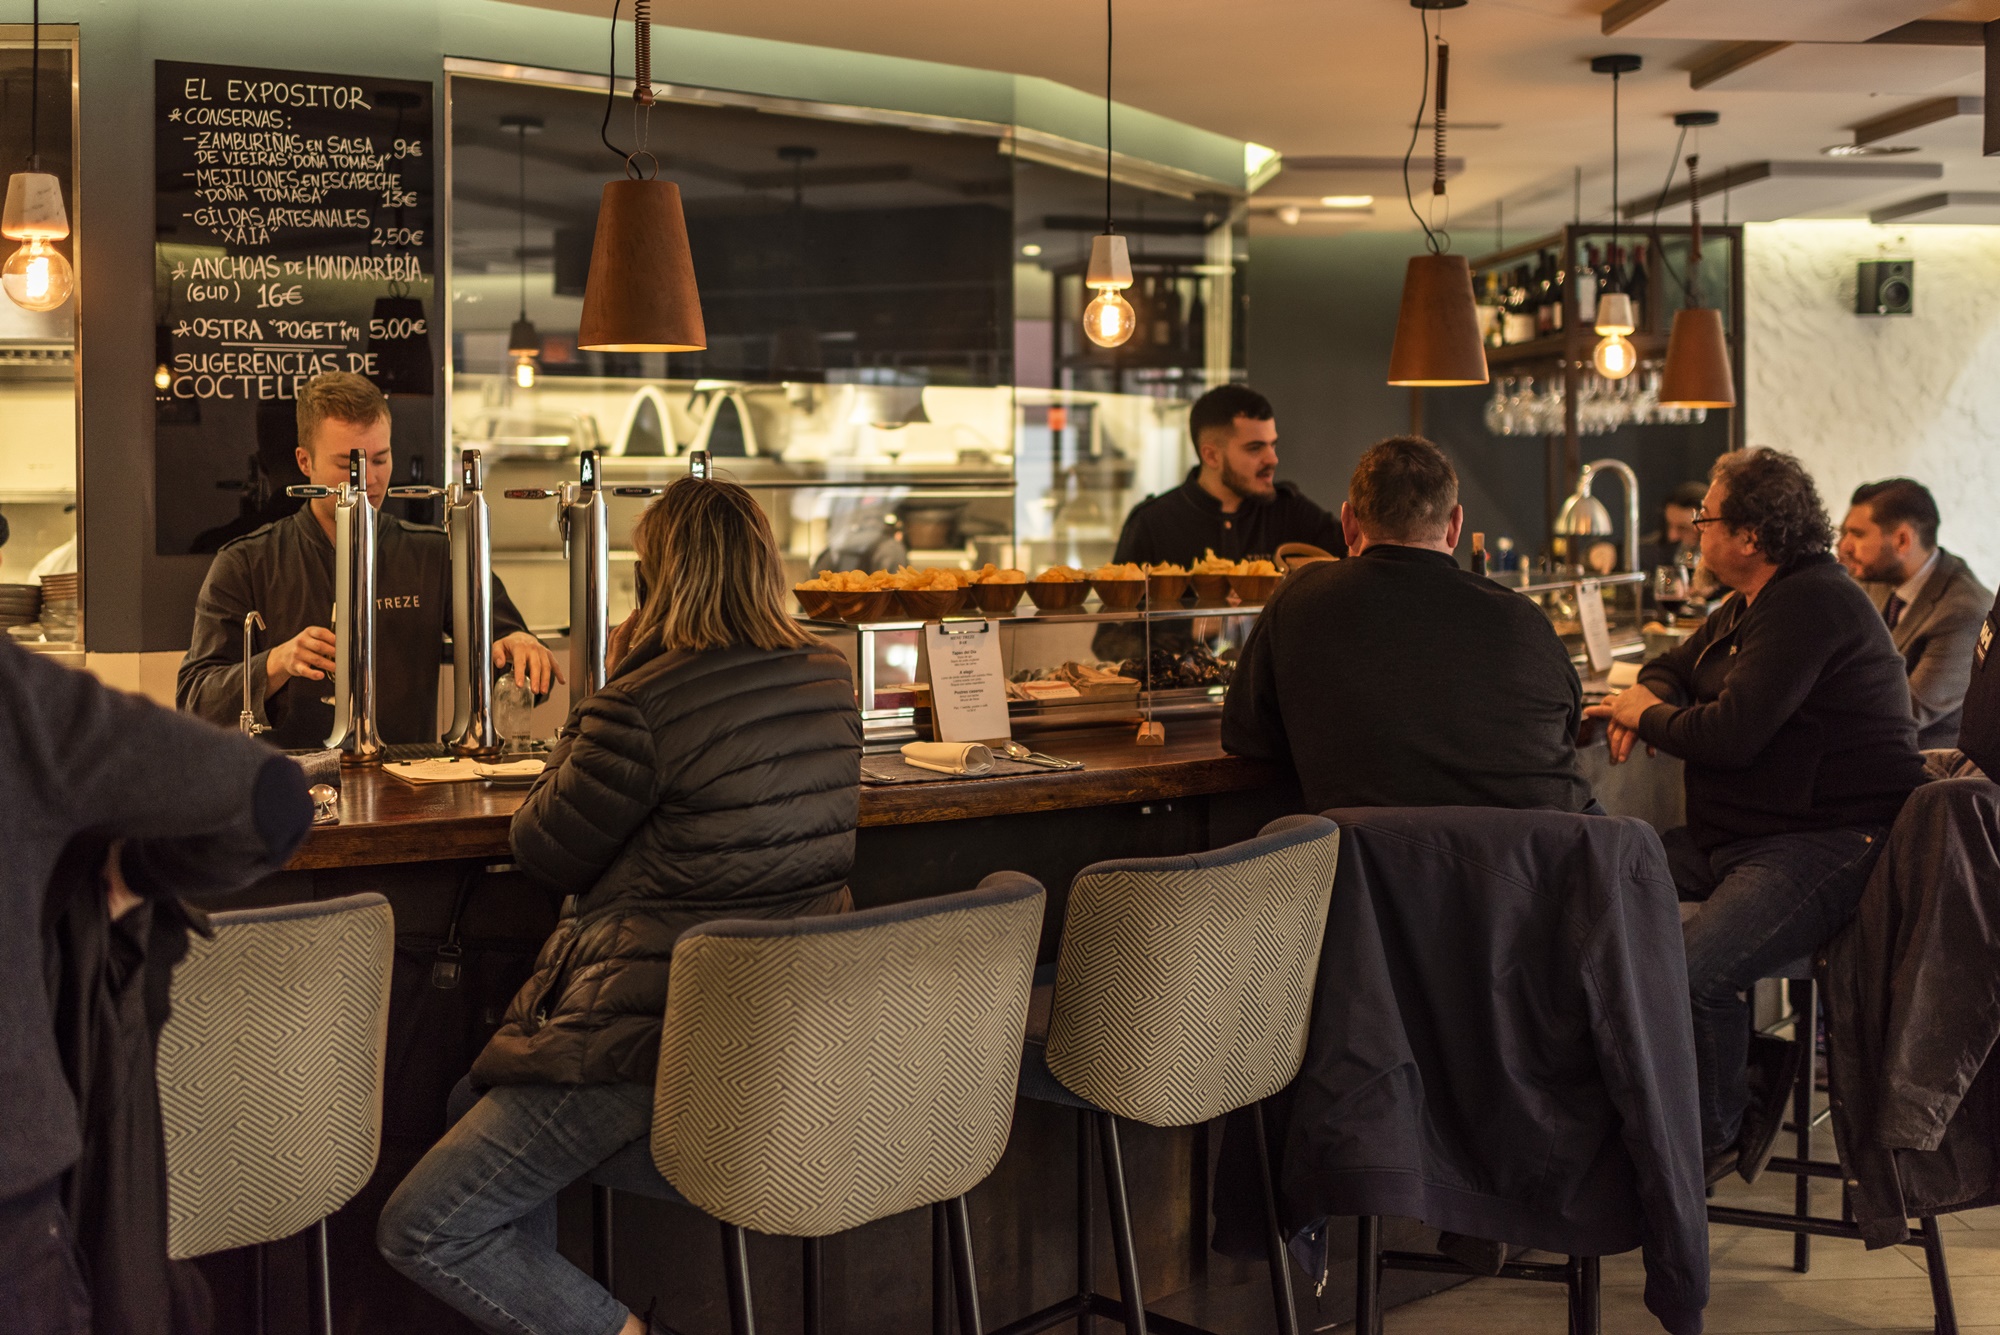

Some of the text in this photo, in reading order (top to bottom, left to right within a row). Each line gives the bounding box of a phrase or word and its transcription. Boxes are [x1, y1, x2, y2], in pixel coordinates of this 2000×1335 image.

[184, 78, 372, 110] EL EXPOSITOR
[184, 107, 292, 129] CONSERVAS:
[194, 149, 220, 164] DE
[222, 150, 288, 167] VIEIRAS
[305, 139, 323, 153] EN
[327, 135, 375, 155] SALSA
[393, 138, 423, 159] 9€
[300, 174, 320, 188] EN
[321, 171, 402, 191] ESCABECHE
[382, 189, 418, 208] 13€
[267, 207, 371, 229] ARTESANALES
[371, 227, 425, 248] 2,50€
[191, 255, 281, 281] ANCHOAS
[284, 260, 304, 276] DE
[257, 283, 304, 309] 16€
[193, 317, 264, 341] OSTRA
[369, 317, 428, 341] 5,00€
[173, 352, 380, 376] SUGERENCIAS DE
[376, 595, 420, 610] TREZE
